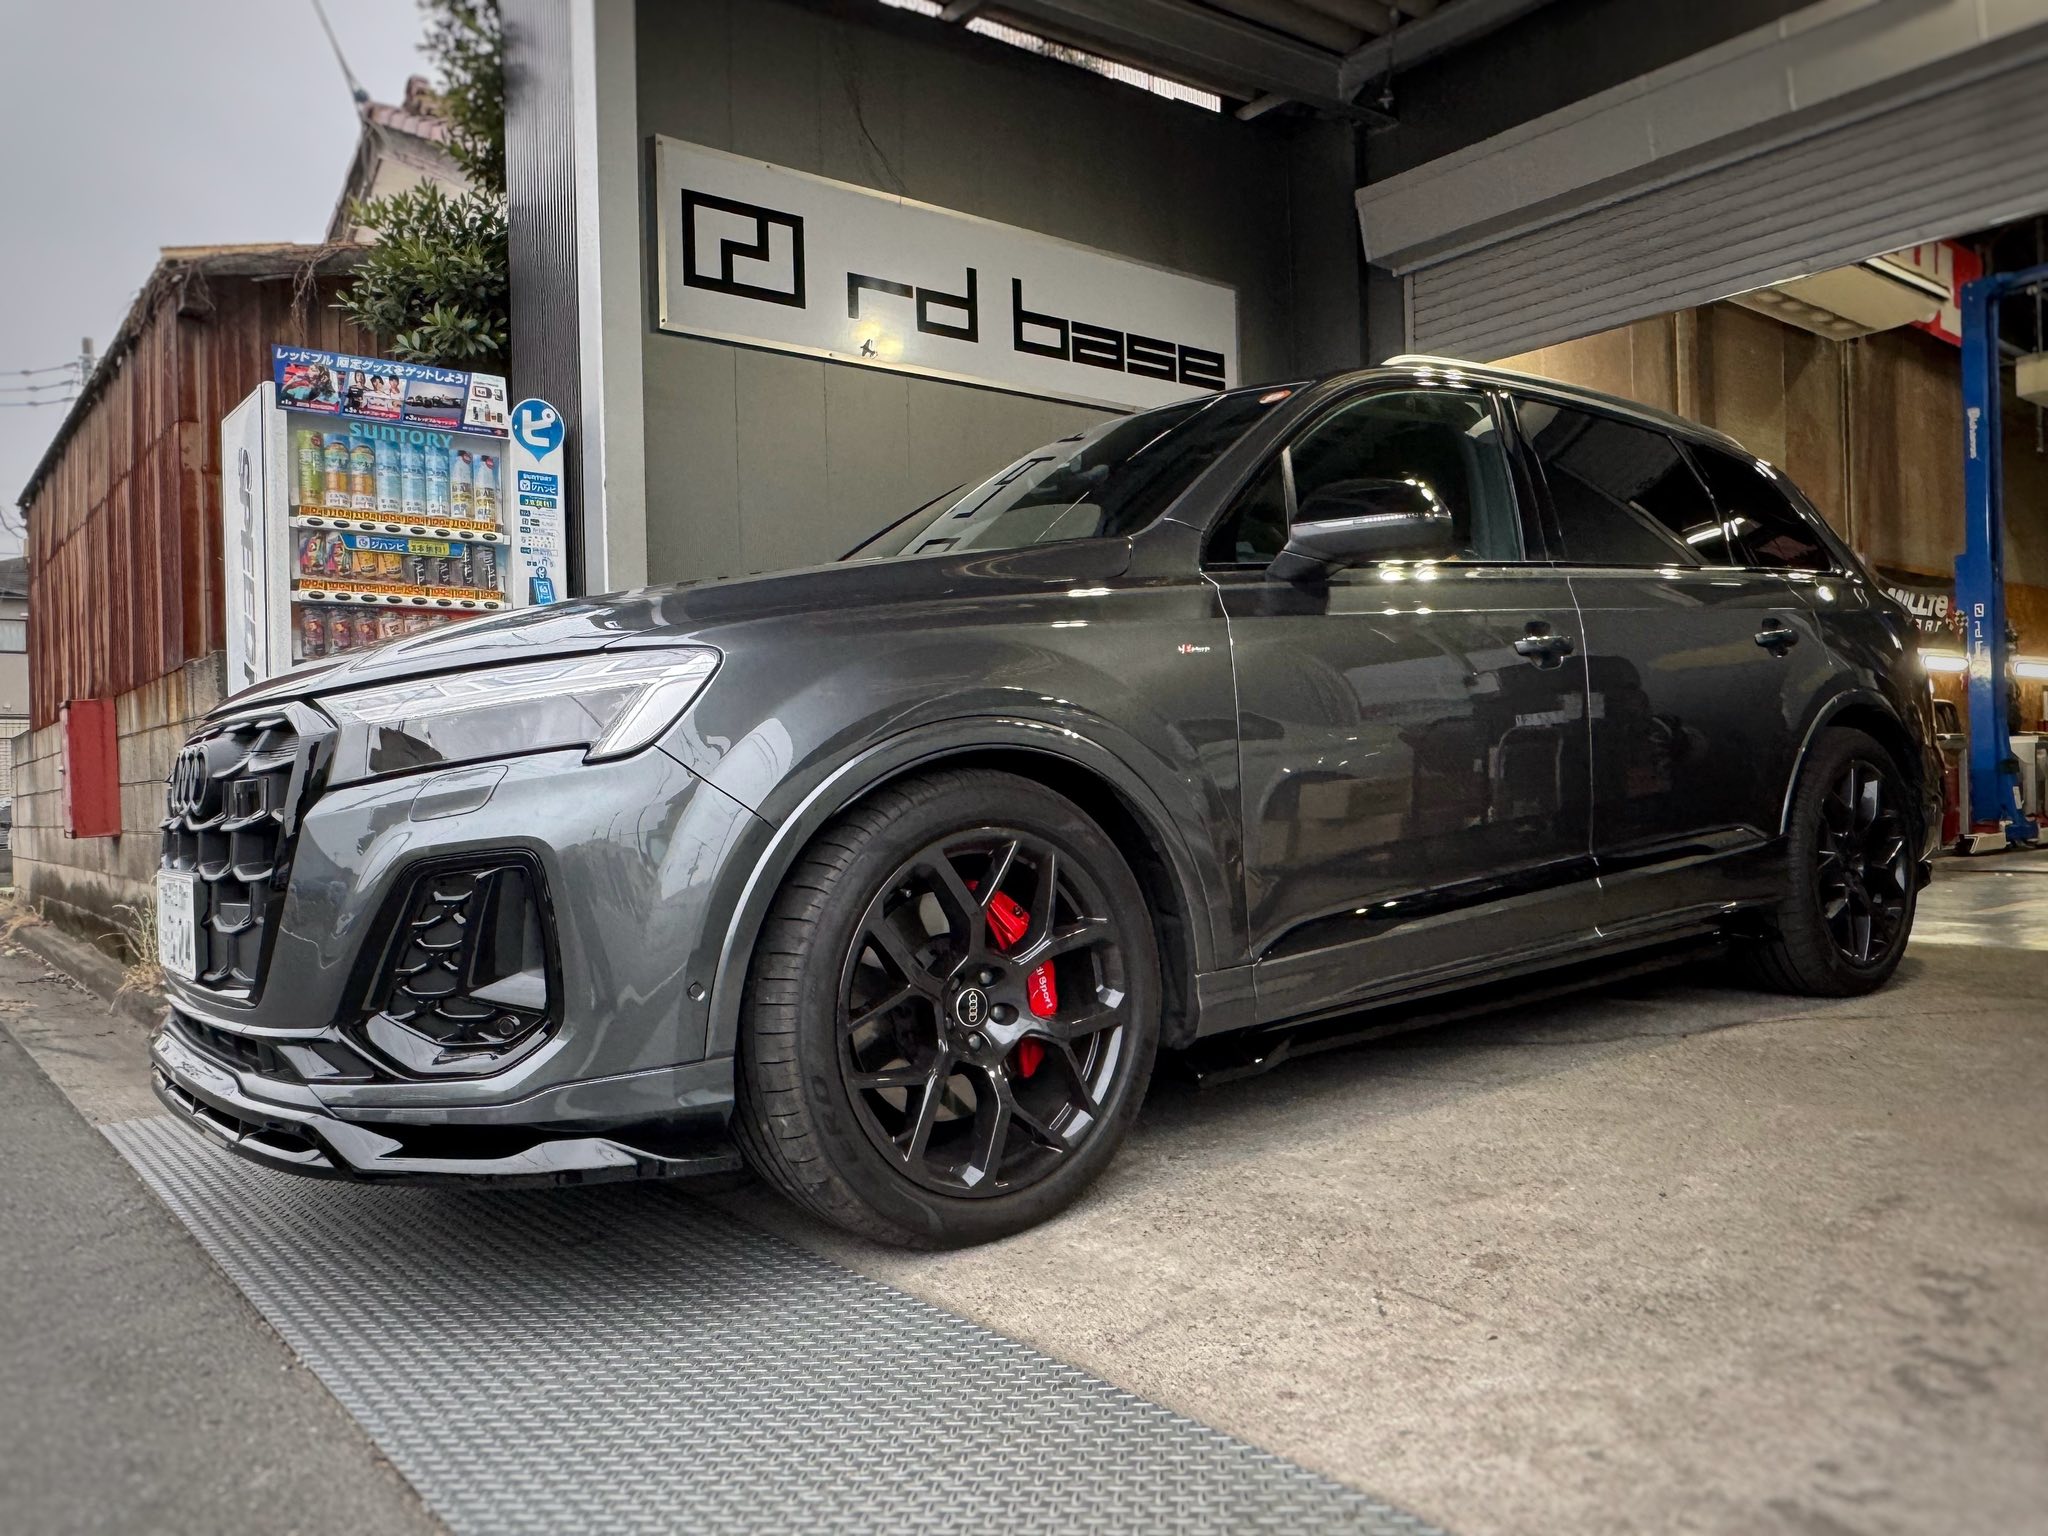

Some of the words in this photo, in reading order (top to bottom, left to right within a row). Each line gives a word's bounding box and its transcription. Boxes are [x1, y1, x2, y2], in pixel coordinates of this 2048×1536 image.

[847, 268, 978, 343] rd
[1012, 277, 1226, 391] base
[350, 422, 453, 449] SUNTORY
[1039, 976, 1053, 1008] Sport
